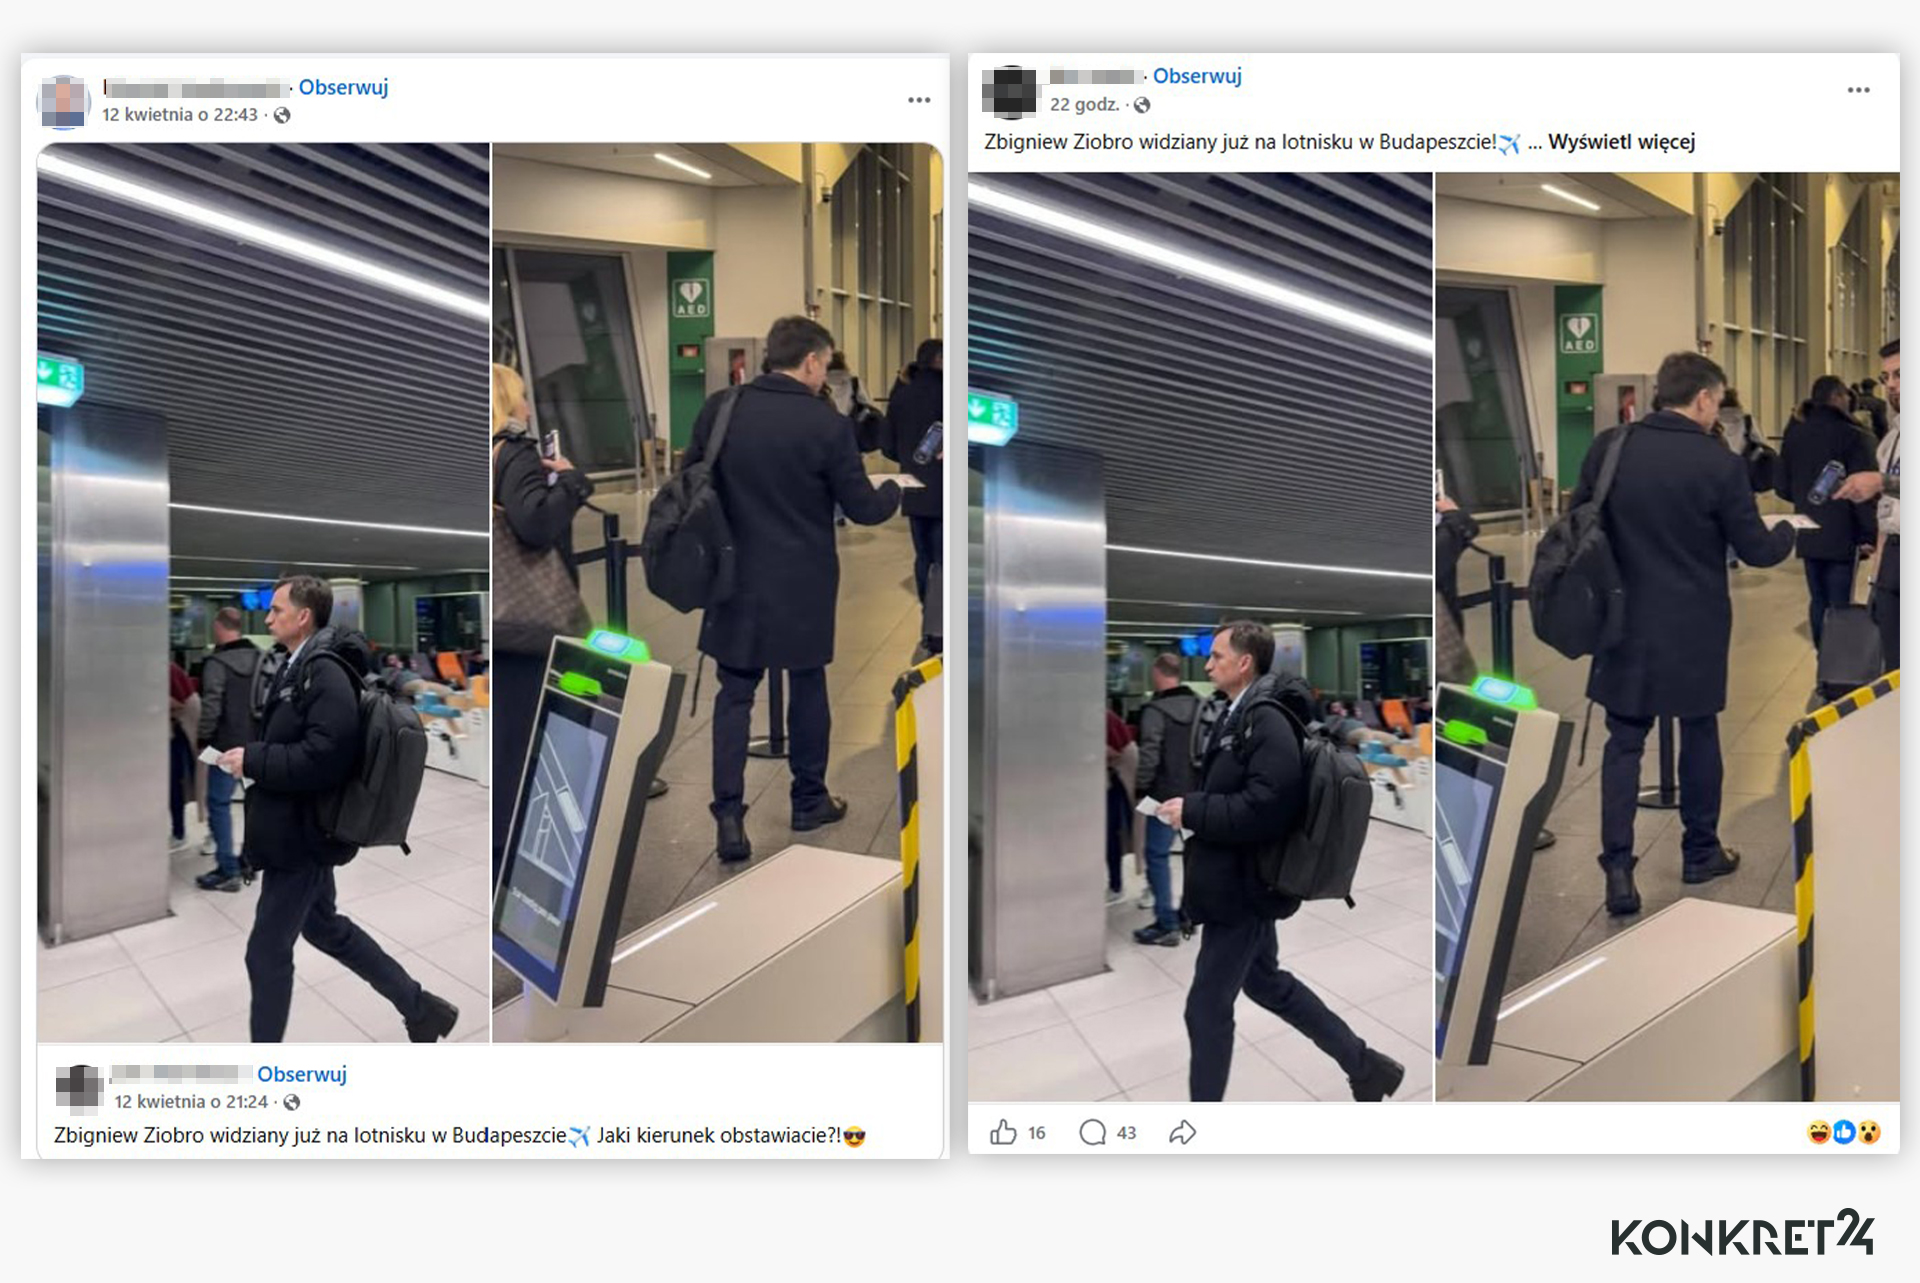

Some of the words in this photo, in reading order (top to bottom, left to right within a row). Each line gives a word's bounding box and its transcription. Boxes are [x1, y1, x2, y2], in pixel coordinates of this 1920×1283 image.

[1153, 65, 1243, 89] Obserwuj
[298, 77, 389, 100] Obserwuj
[102, 107, 120, 122] 12
[125, 106, 193, 122] kwietnia
[197, 110, 209, 122] o
[213, 107, 259, 122] 22:43
[1050, 97, 1070, 112] 22
[1074, 96, 1120, 116] godz.
[983, 132, 1069, 154] Zbigniew
[1072, 132, 1134, 150] Ziobro
[1138, 132, 1218, 154] widziany
[1219, 132, 1250, 154] już
[1254, 136, 1276, 150] na
[1282, 132, 1353, 150] lotnisku
[1358, 137, 1375, 150] w
[1379, 132, 1497, 154] Budapeszcie!
[1547, 132, 1632, 154] Wyświetl
[1637, 131, 1696, 154] więcej
[677, 304, 706, 315] AED
[1565, 340, 1594, 351] AED
[257, 1064, 348, 1087] Obserwuj
[114, 1094, 132, 1109] 12
[137, 1093, 206, 1109] kwietnia
[209, 1097, 221, 1109] o
[226, 1094, 269, 1109] 21:24
[53, 1126, 139, 1148] Zbigniew
[142, 1126, 205, 1144] Ziobro
[209, 1126, 290, 1148] widziany
[291, 1126, 322, 1148] już
[326, 1130, 348, 1144] na
[354, 1126, 426, 1144] lotnisku
[431, 1130, 448, 1144] w
[452, 1126, 567, 1148] Budapeszcie
[596, 1126, 631, 1144] Jaki
[637, 1126, 716, 1144] kierunek
[719, 1126, 842, 1144] obstawiacie?!
[1028, 1125, 1046, 1140] 16
[1116, 1125, 1137, 1140] 43
